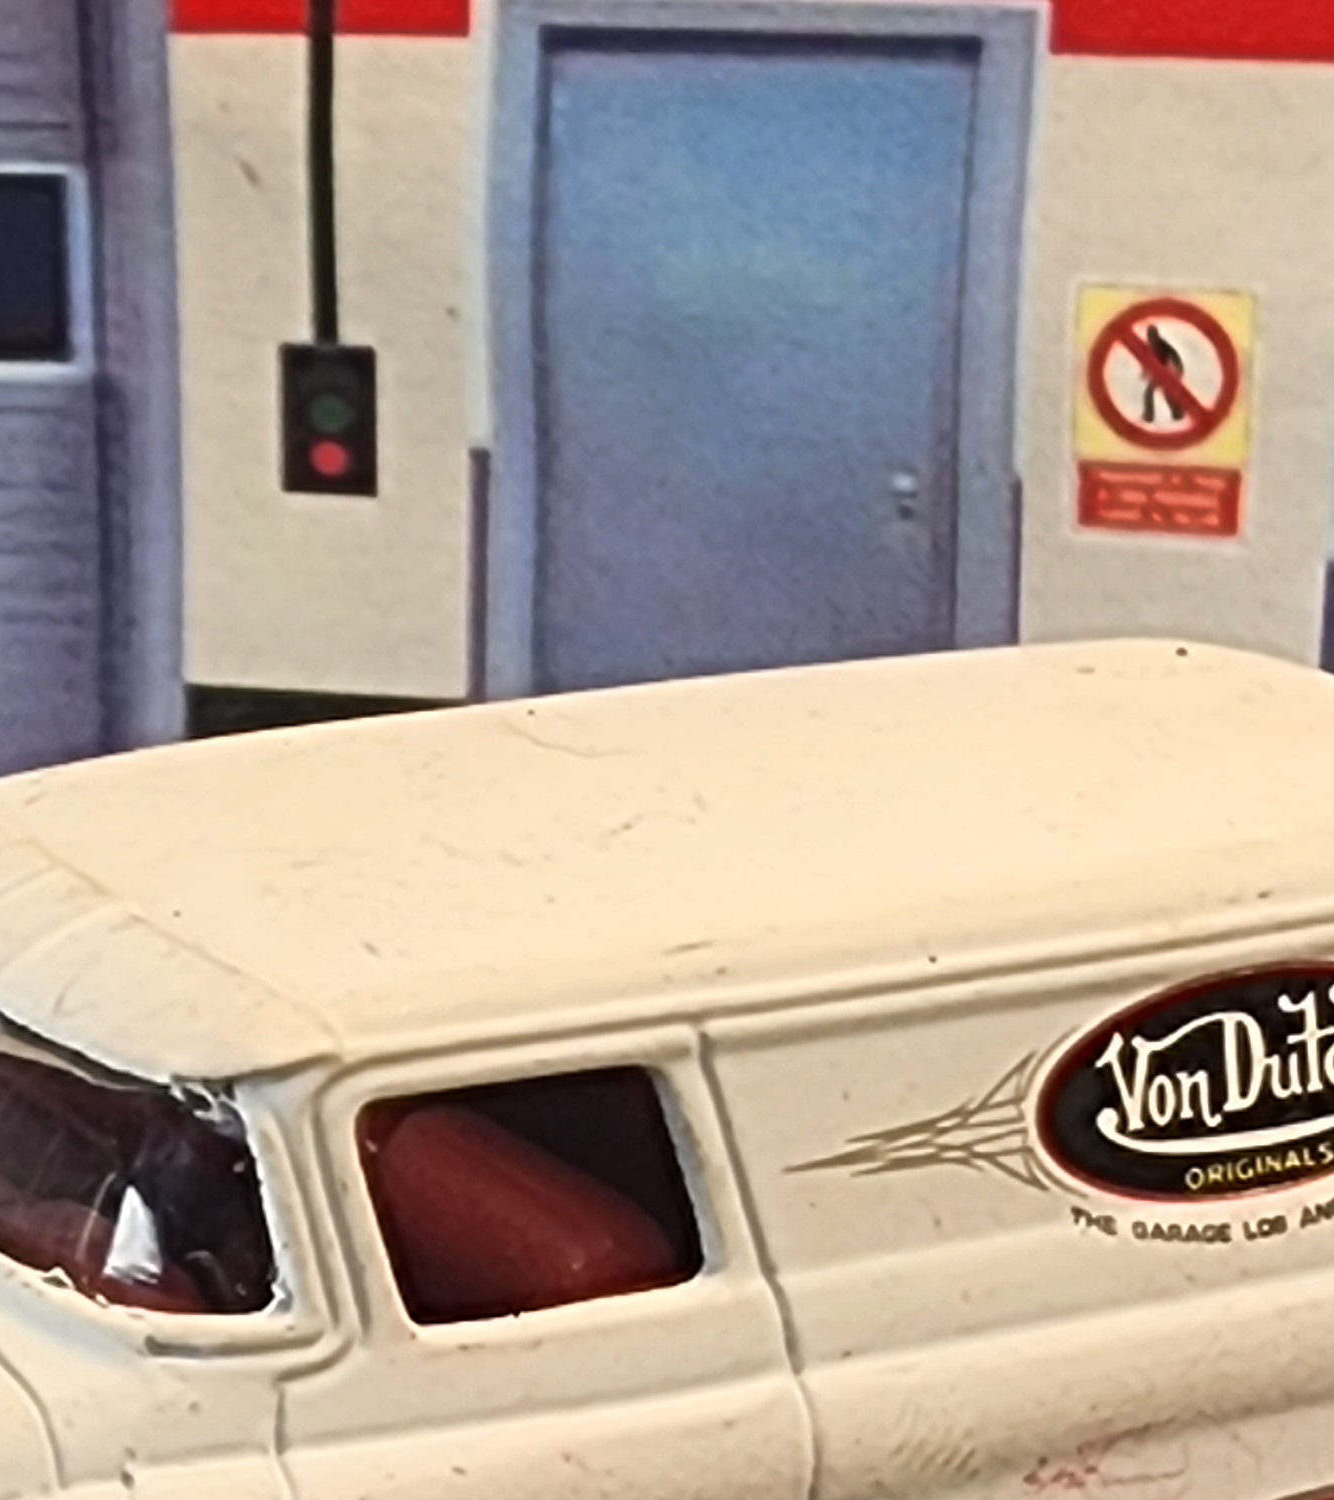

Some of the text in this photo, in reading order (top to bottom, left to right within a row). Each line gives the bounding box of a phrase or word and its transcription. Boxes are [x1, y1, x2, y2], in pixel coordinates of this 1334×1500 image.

[1095, 1031, 1223, 1133] Von
[1070, 1206, 1119, 1236] THE
[1131, 1220, 1233, 1244] GARAGE
[1242, 1214, 1288, 1240] LOS
